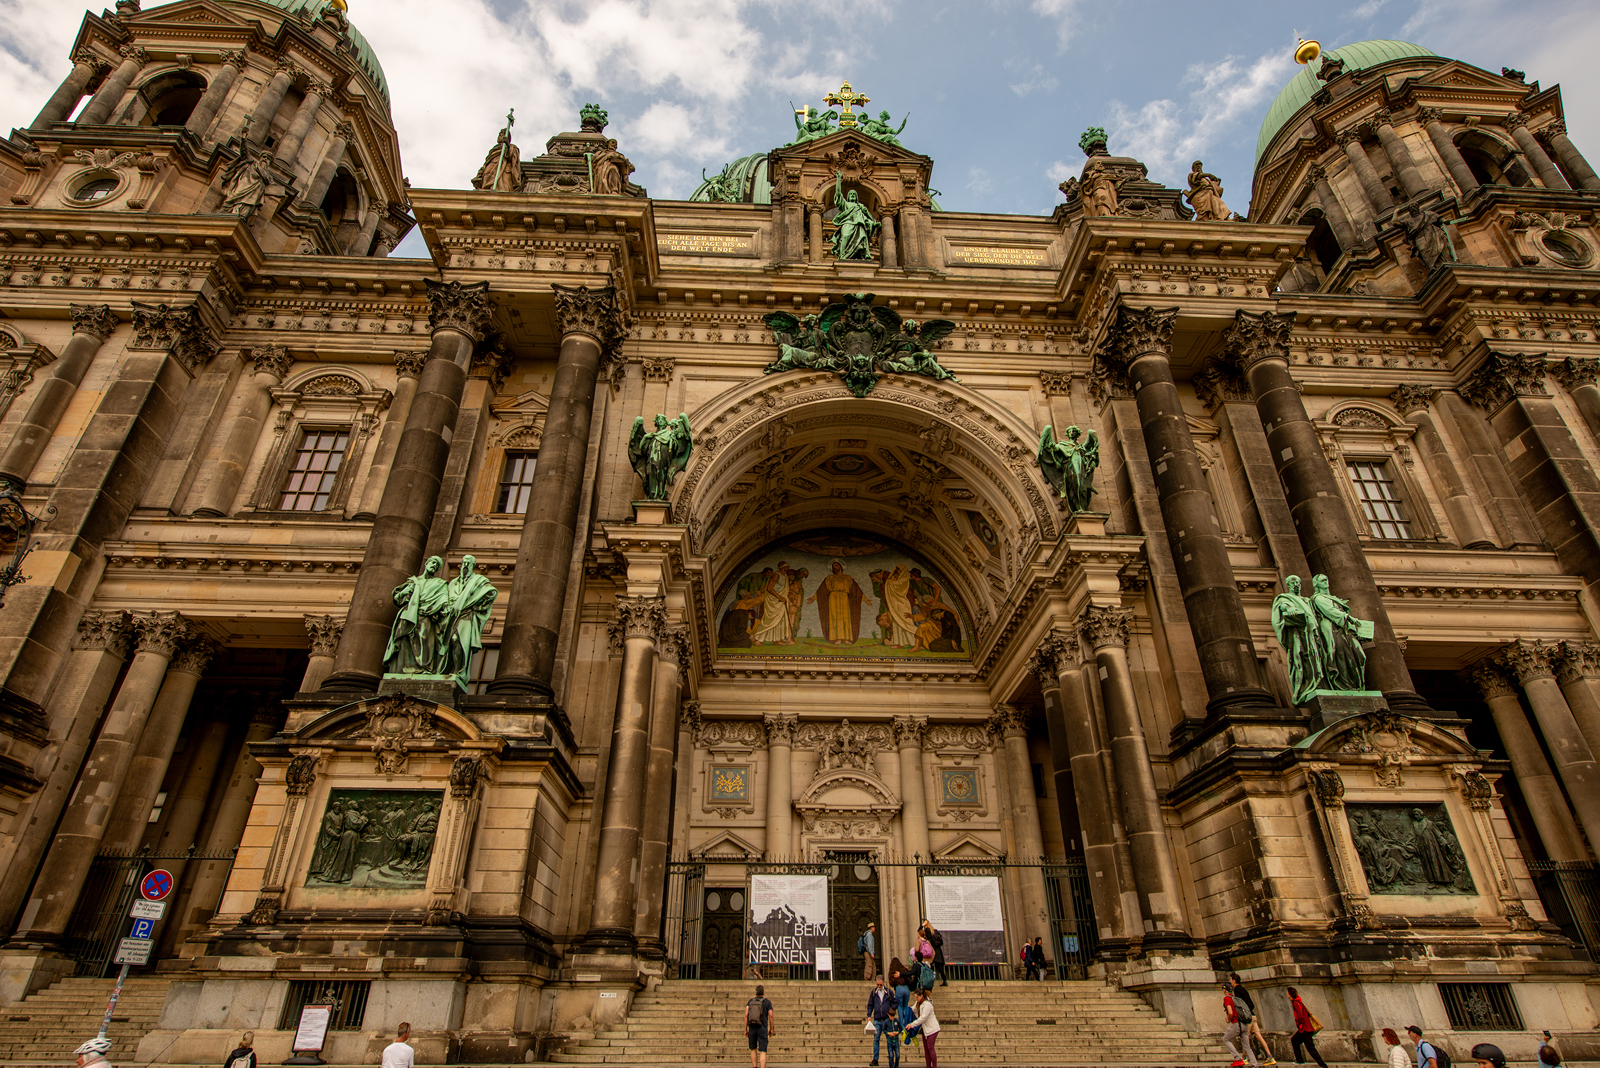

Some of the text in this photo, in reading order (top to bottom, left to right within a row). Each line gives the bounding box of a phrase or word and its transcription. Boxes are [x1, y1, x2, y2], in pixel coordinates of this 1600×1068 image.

[964, 257, 1020, 265] UEBERWUNDEN
[135, 921, 149, 936] P
[794, 923, 828, 936] BEIM
[750, 936, 802, 950] NAMEN
[749, 949, 810, 963] NENNEN
